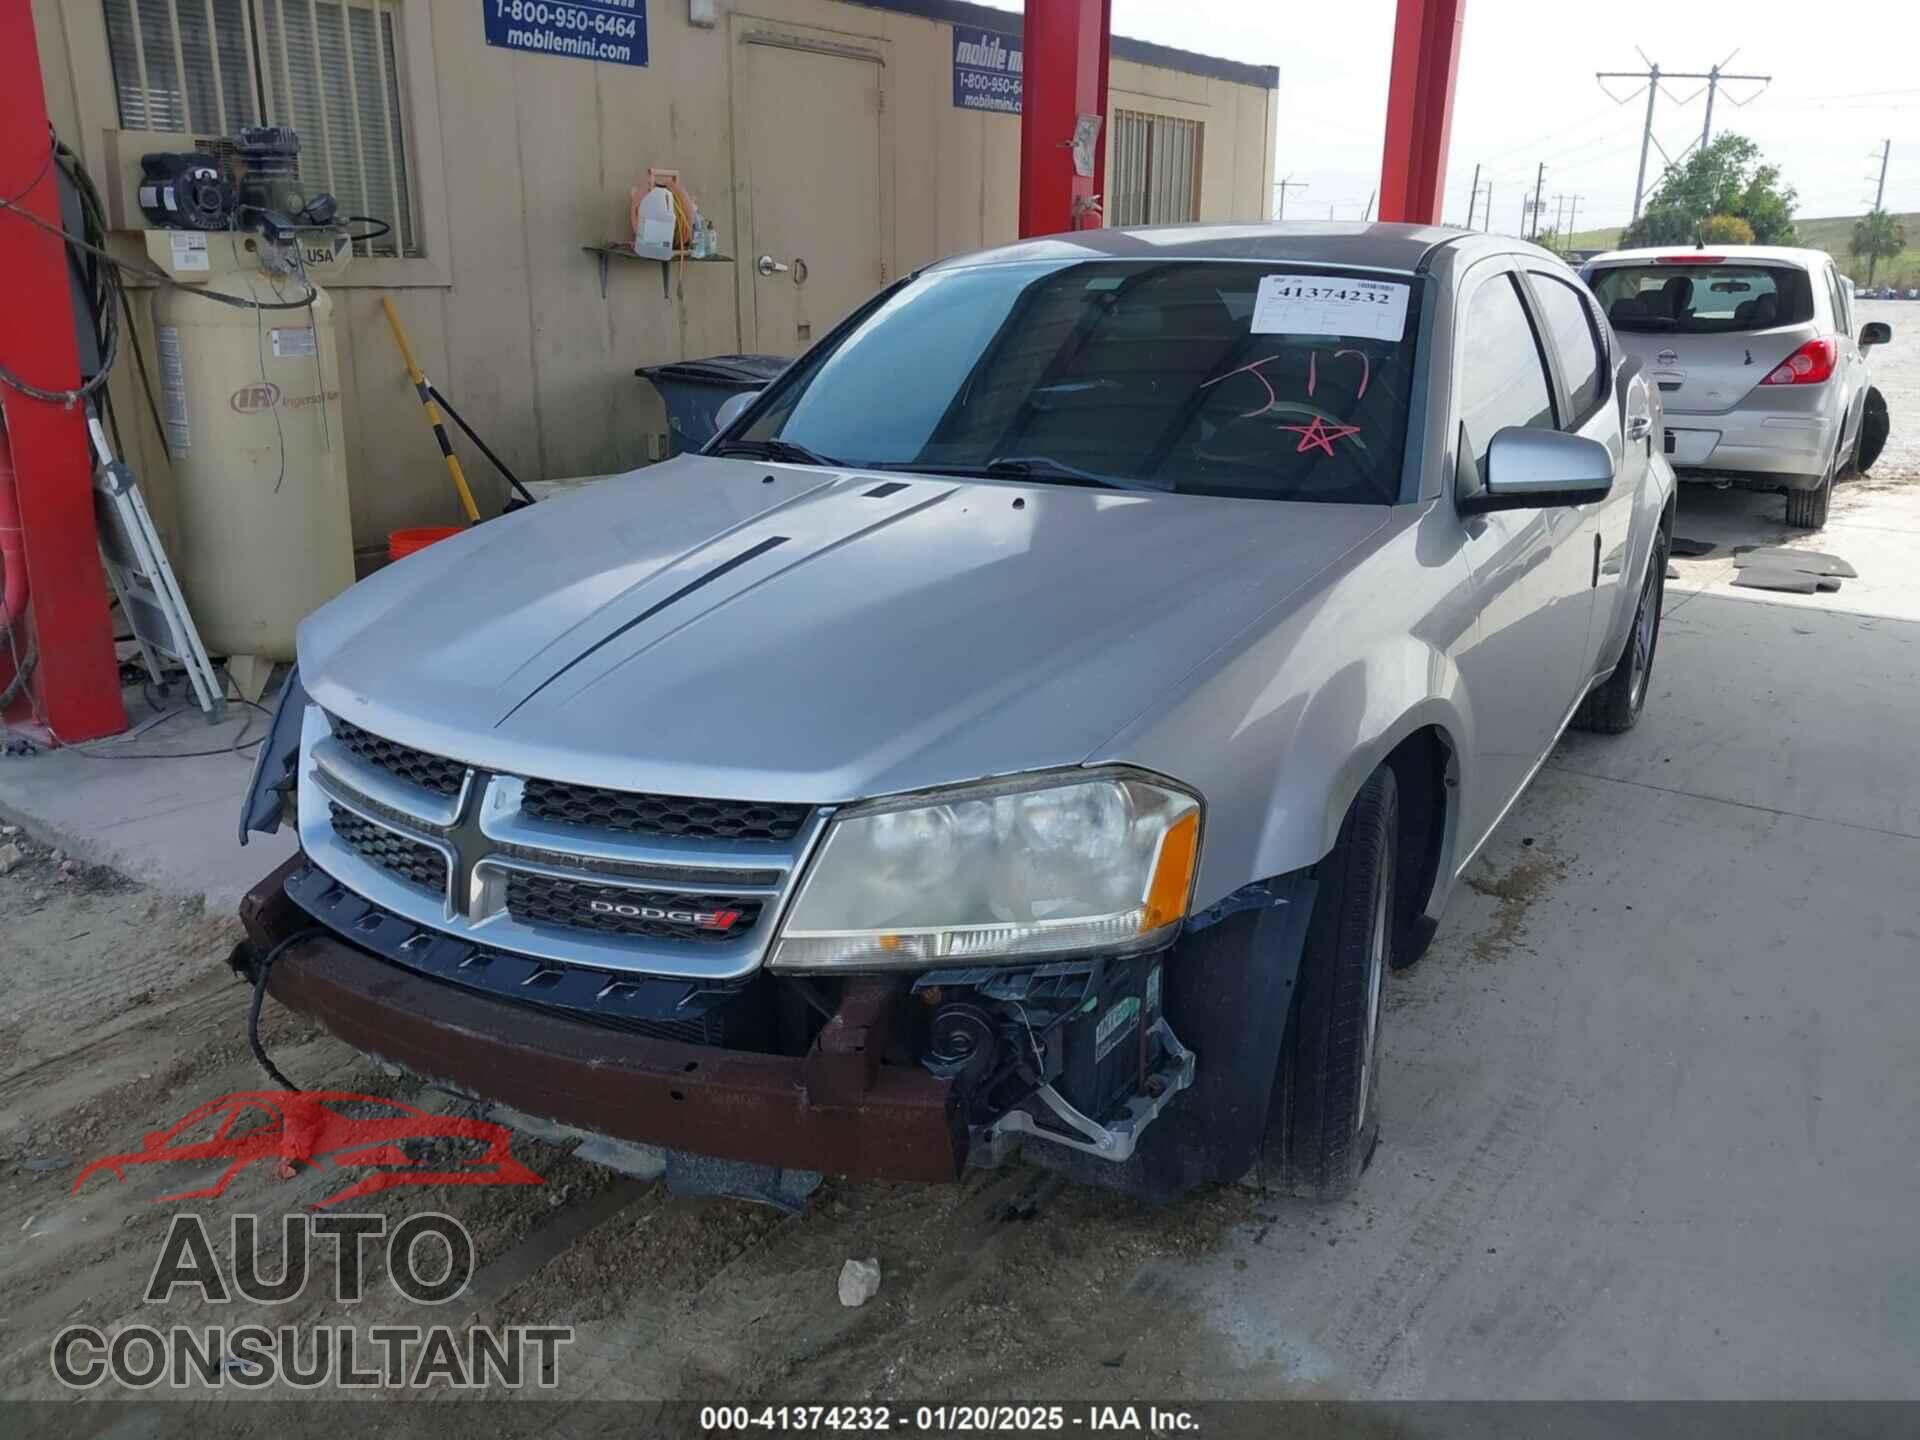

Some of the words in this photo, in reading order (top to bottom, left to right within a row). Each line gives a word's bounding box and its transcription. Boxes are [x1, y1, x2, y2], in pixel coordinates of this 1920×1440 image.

[497, 0, 636, 38] 1-800-950-6464
[507, 28, 631, 61] mobilemini.com
[956, 34, 1007, 70] mobile
[307, 248, 334, 263] USA
[1278, 286, 1390, 305] 41374232
[590, 900, 717, 925] DODGE
